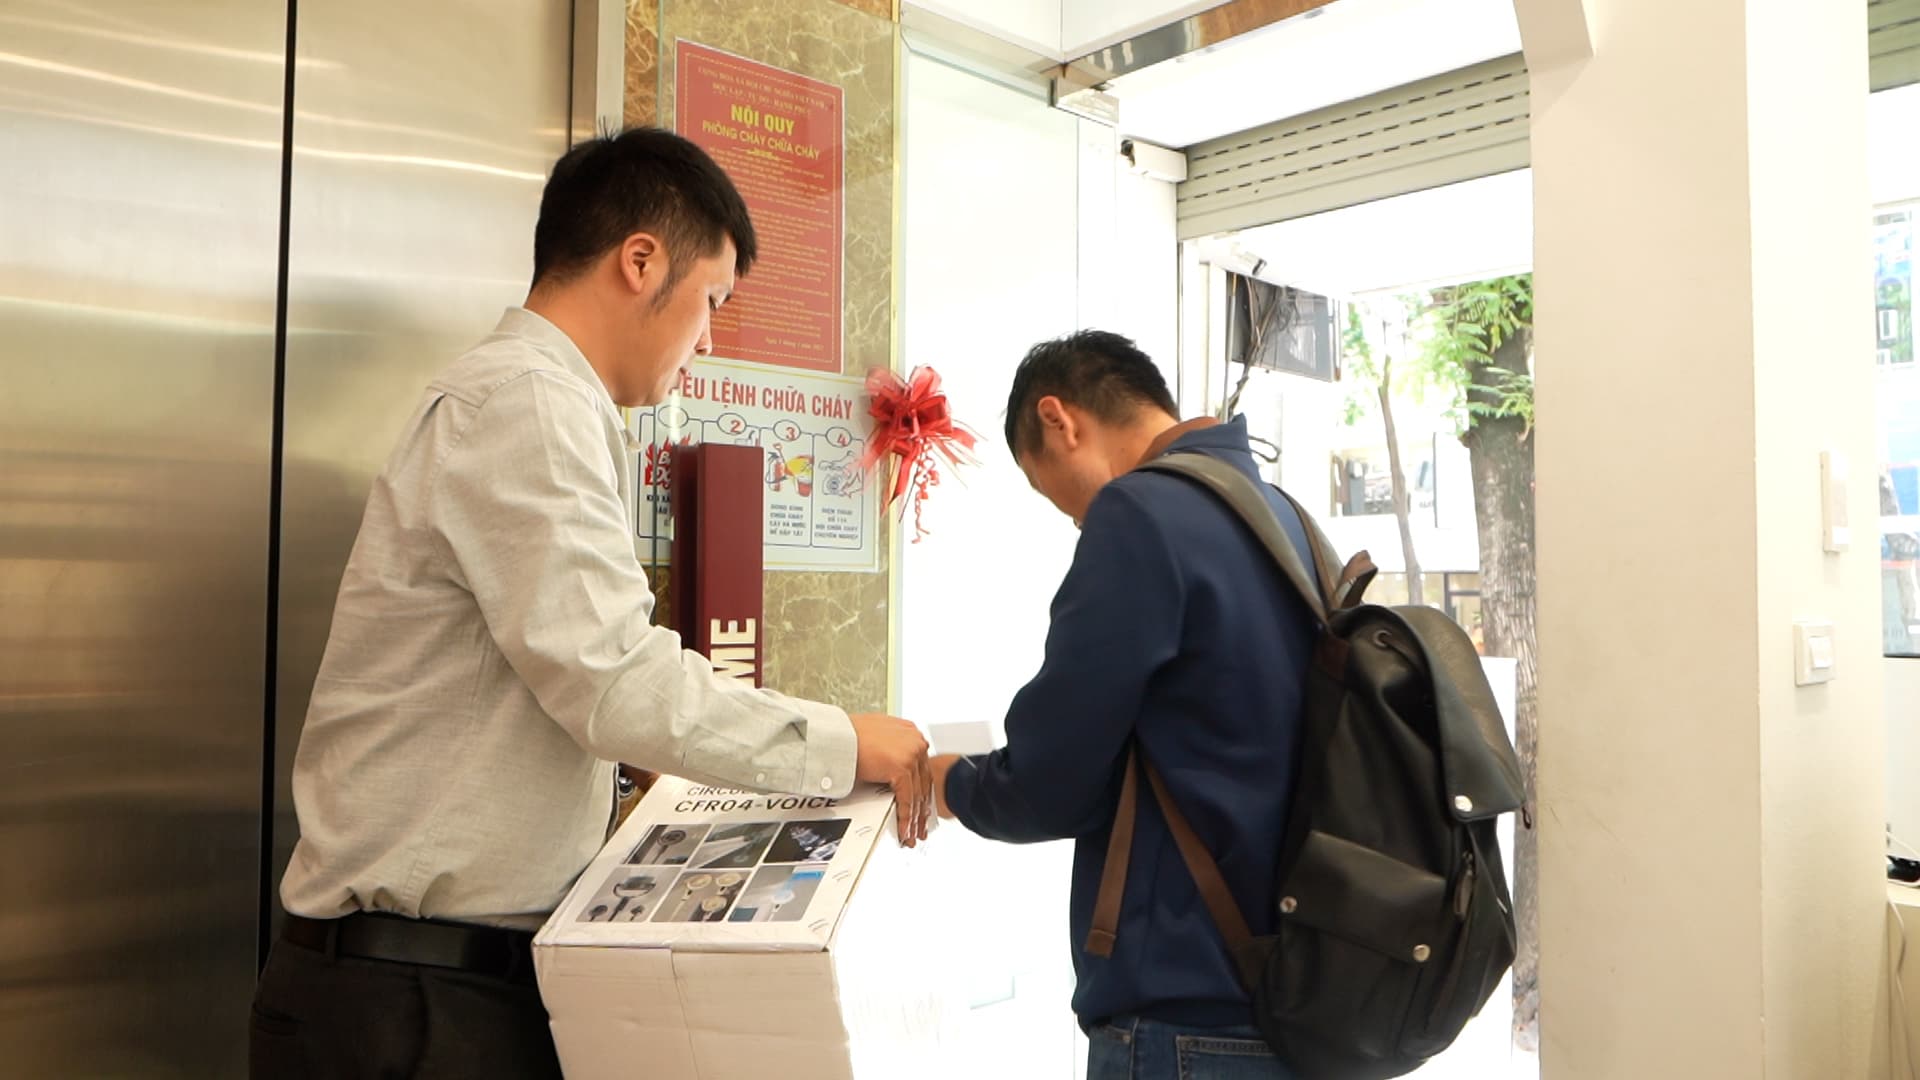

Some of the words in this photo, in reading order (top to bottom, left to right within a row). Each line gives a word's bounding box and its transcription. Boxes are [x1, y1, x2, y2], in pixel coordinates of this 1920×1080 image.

[731, 104, 759, 129] NỘI
[764, 113, 794, 136] QUY
[702, 119, 738, 140] PHÒNG
[739, 130, 766, 146] CHÁY
[767, 136, 794, 154] CHỮA
[794, 144, 820, 161] CHÁY
[712, 377, 757, 409] LỆNH
[762, 385, 806, 414] CHỮA
[811, 393, 853, 421] CHÁY
[730, 419, 741, 433] 2
[785, 426, 796, 441] 3
[836, 433, 848, 447] 4
